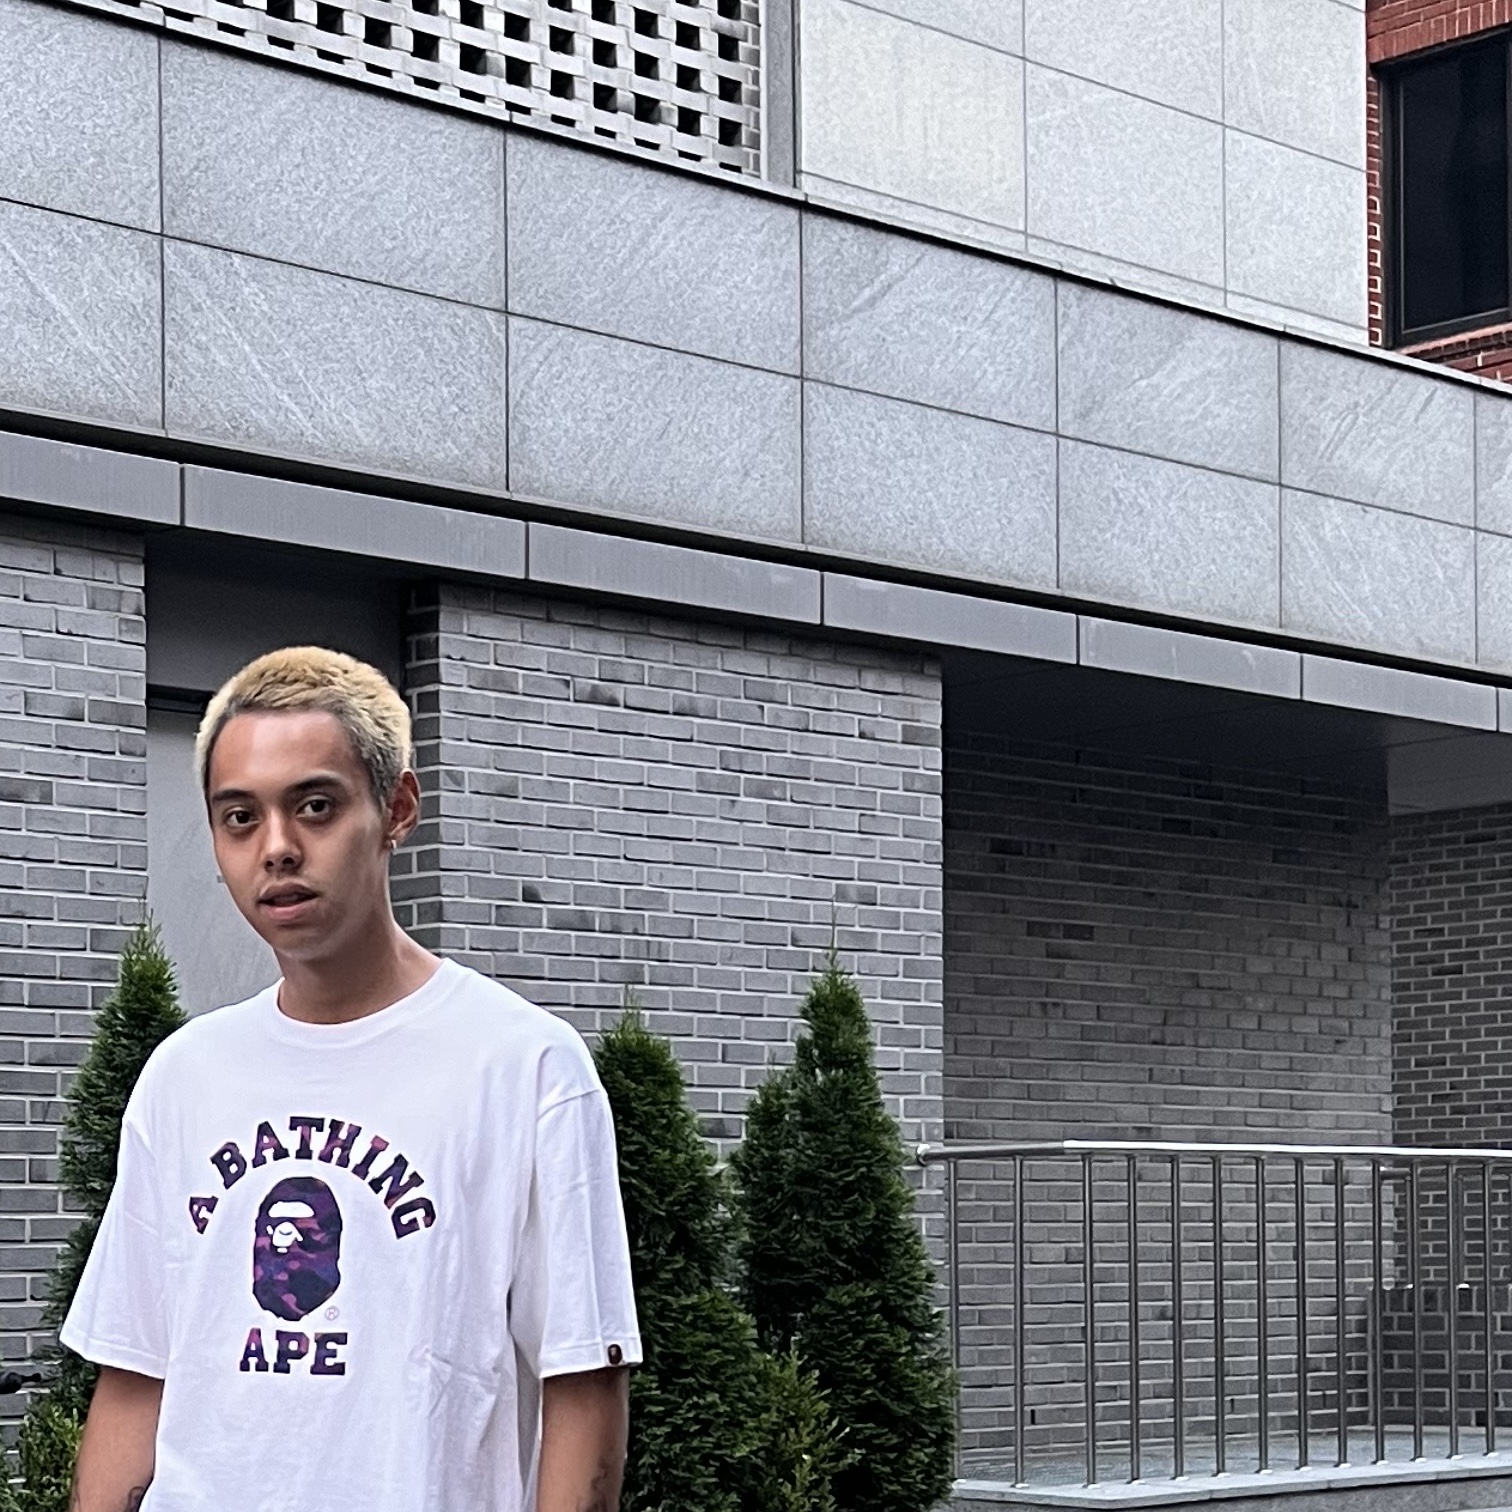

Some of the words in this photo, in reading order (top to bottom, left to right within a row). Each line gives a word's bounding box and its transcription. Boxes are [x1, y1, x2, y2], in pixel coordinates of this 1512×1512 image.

[189, 1195, 219, 1234] A
[210, 1116, 437, 1240] BATHING
[239, 1327, 348, 1376] APE
